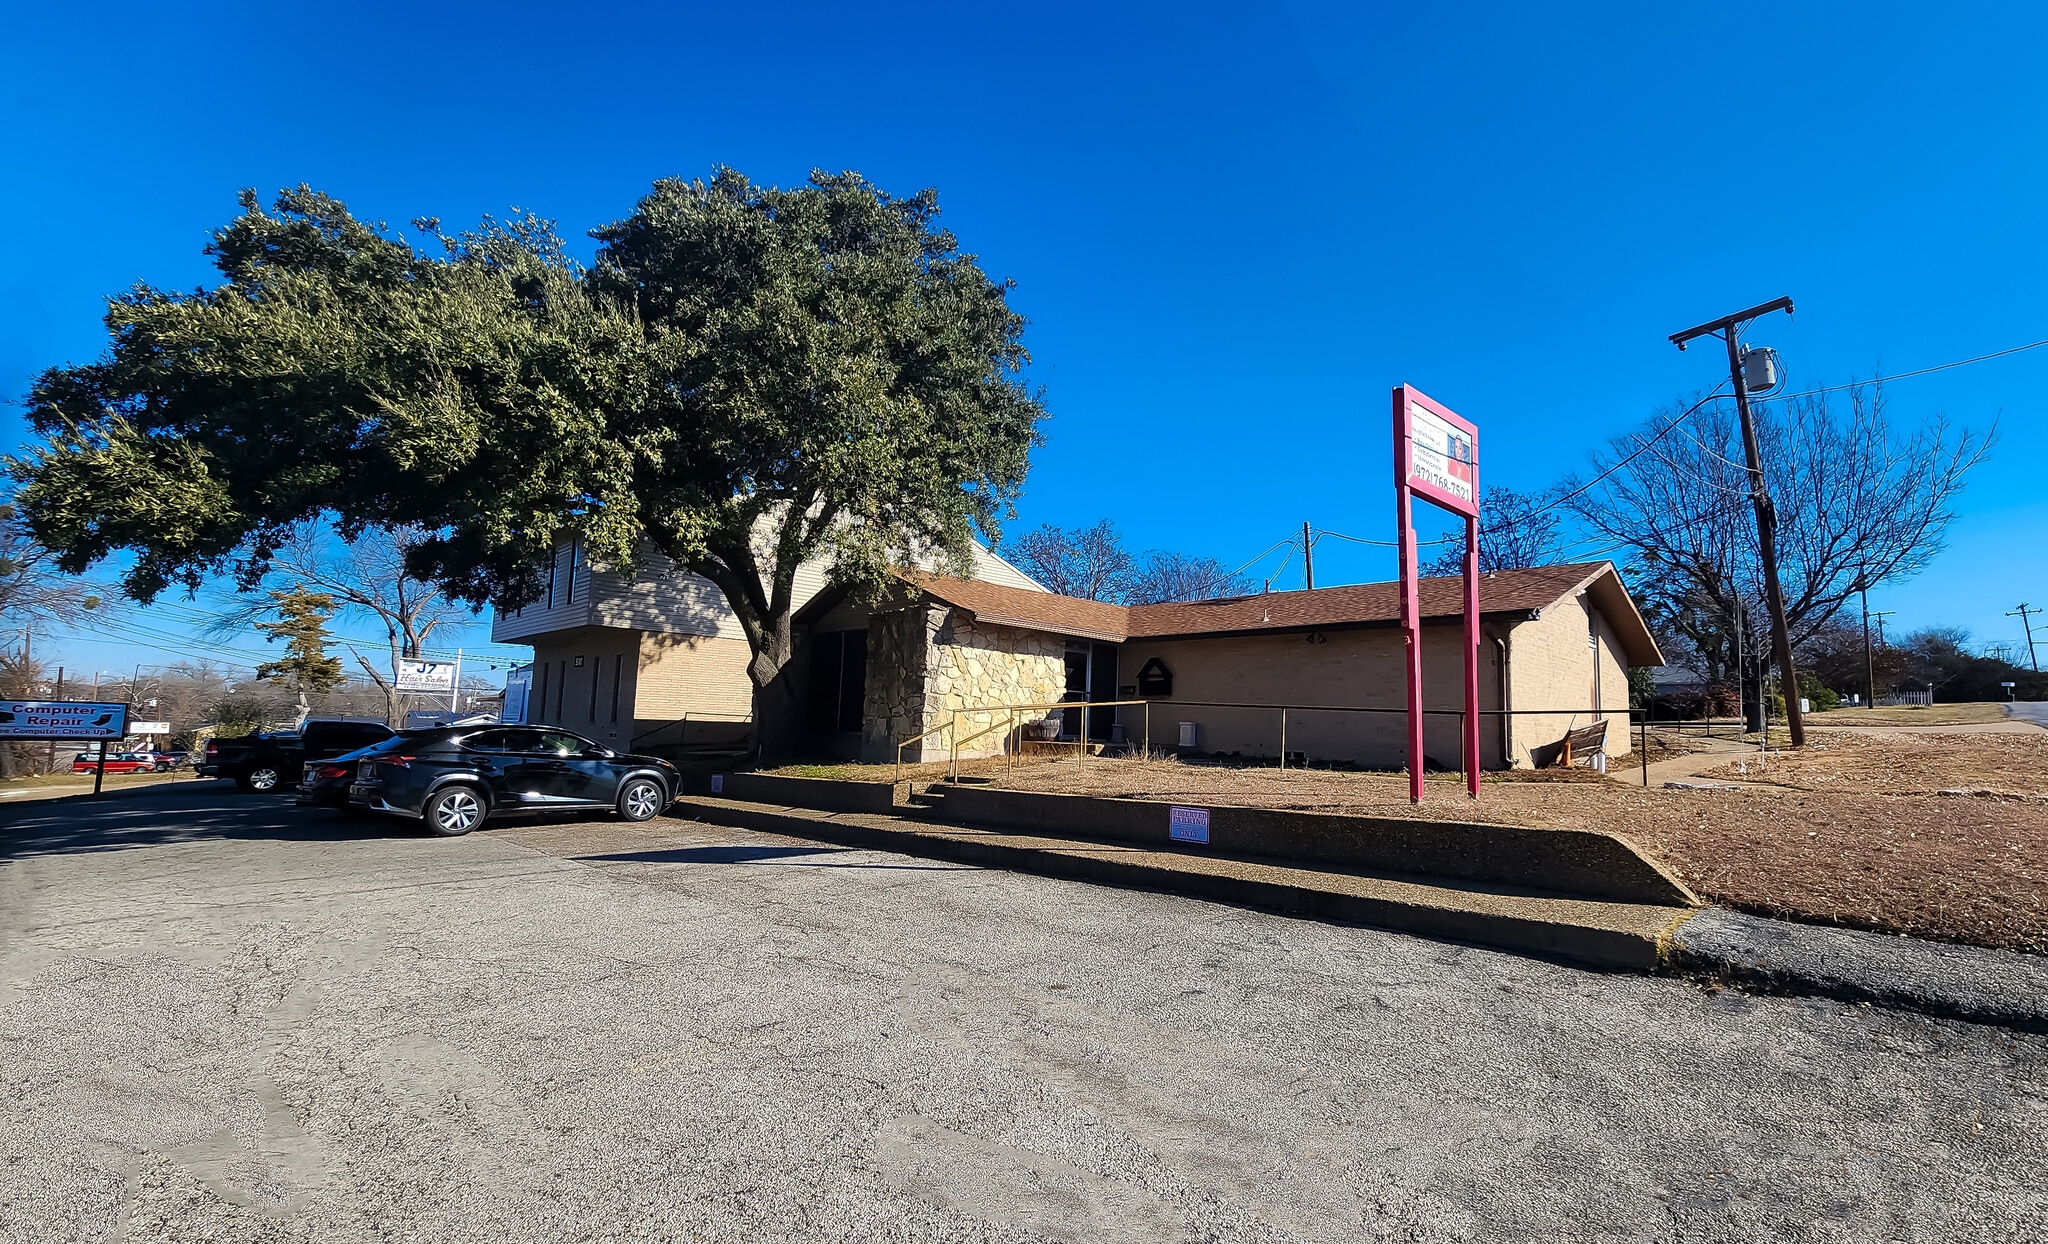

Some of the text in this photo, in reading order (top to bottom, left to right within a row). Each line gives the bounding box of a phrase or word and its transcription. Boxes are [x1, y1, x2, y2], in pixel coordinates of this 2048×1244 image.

[1433, 473, 1470, 502] 768-7521
[416, 663, 437, 674] J7
[400, 674, 449, 683] Hair Salon
[12, 704, 97, 715] Computer
[27, 716, 84, 726] Repair
[13, 727, 60, 735] Computer
[1173, 810, 1206, 819] RESERVED
[1173, 816, 1206, 825] PARKING
[1179, 830, 1199, 838] ONLY
